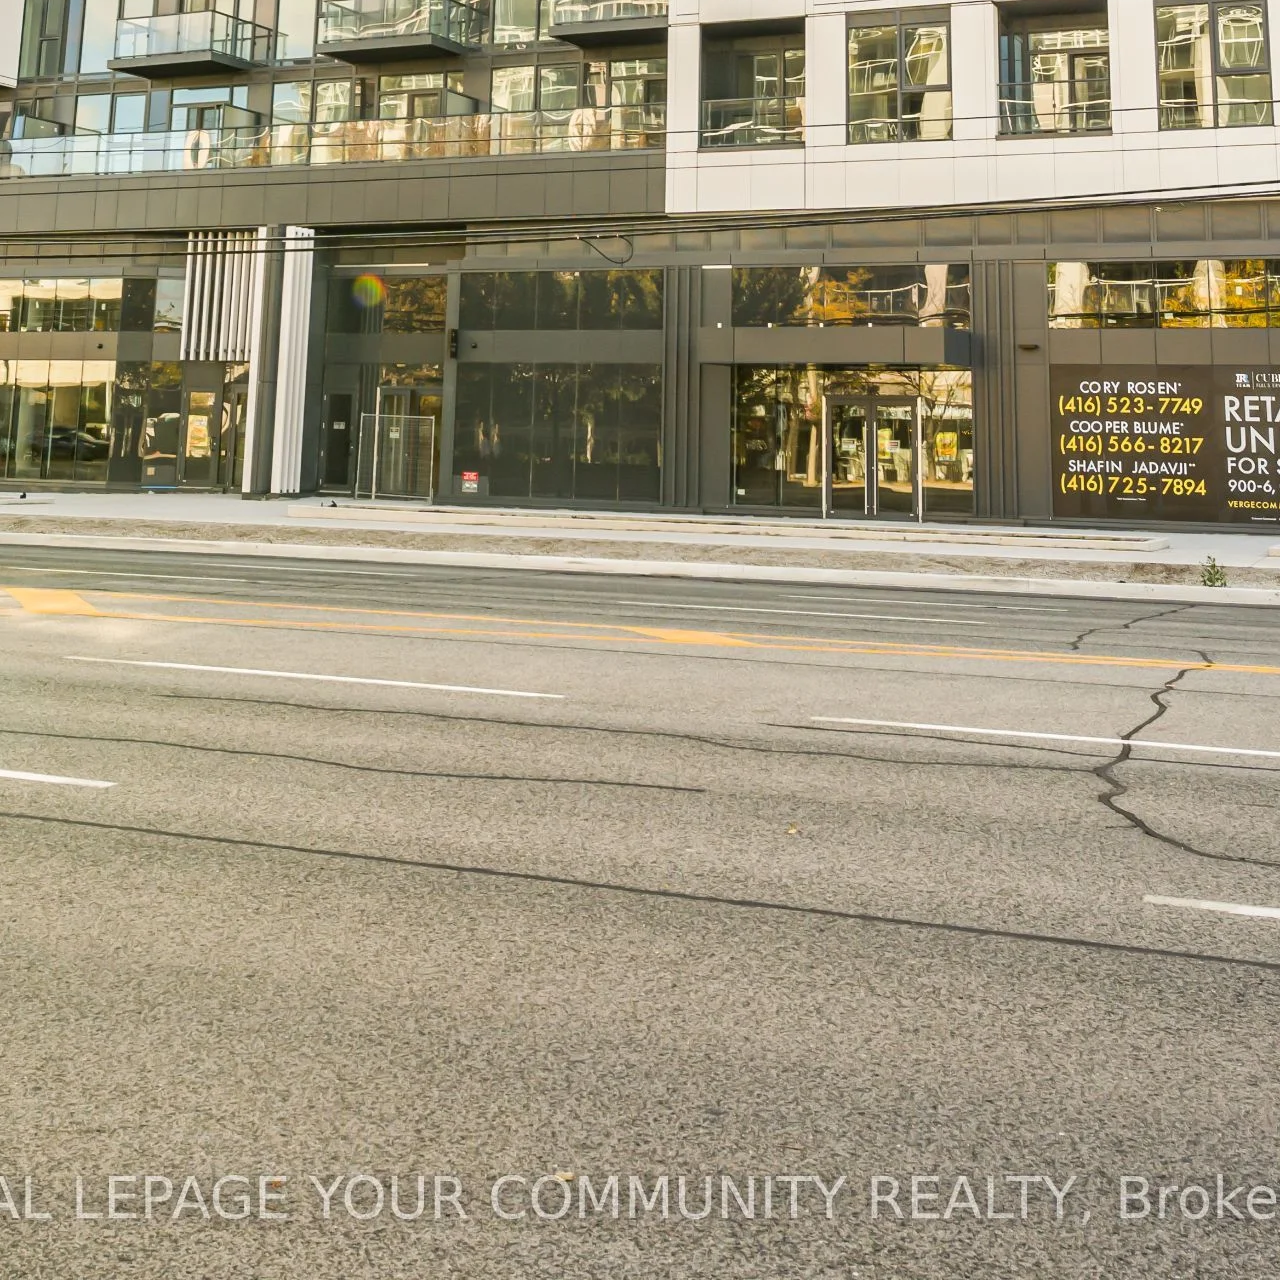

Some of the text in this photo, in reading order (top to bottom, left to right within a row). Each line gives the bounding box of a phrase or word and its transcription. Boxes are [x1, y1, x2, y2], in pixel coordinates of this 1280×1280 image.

[1080, 381, 1120, 394] CORY
[1058, 395, 1101, 416] (416)
[1070, 420, 1129, 434] COOPER
[1060, 434, 1102, 455] (416)
[1068, 460, 1122, 473] SHAFIN
[1227, 457, 1269, 474] FOR
[1061, 473, 1103, 495] (416)
